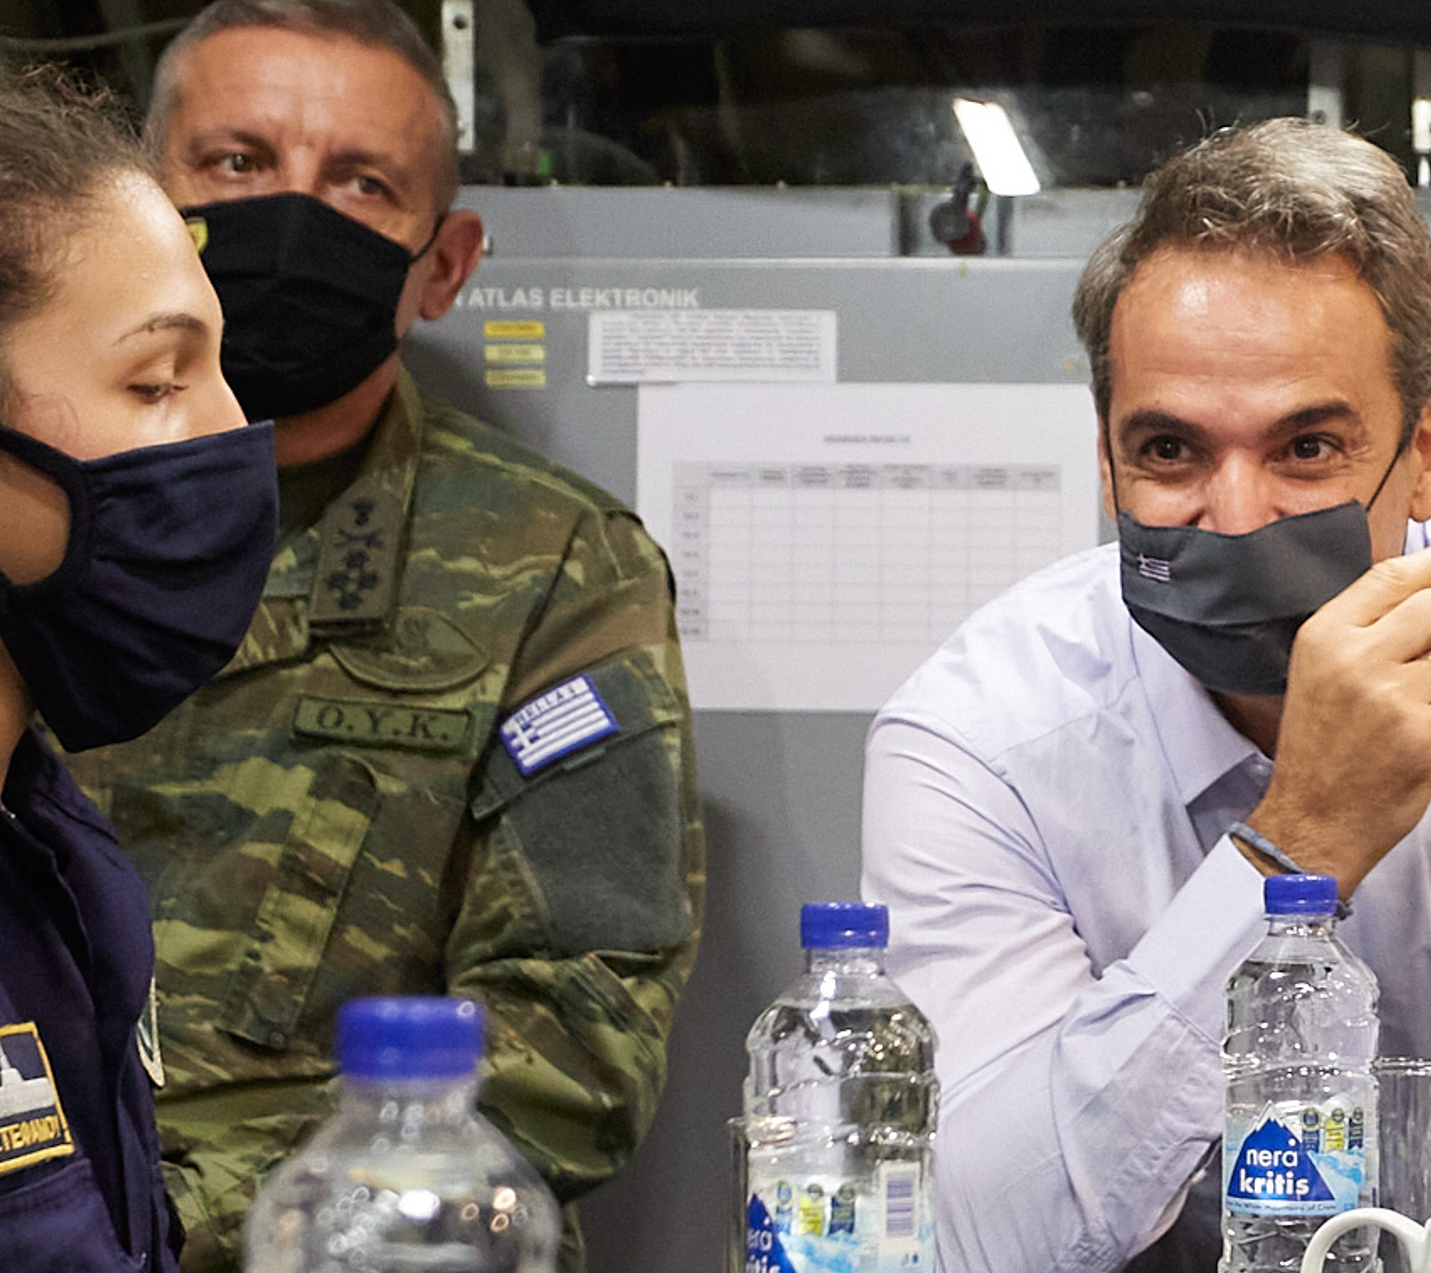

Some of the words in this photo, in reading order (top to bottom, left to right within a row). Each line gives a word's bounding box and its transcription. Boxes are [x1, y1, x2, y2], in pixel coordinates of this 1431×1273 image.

[469, 287, 543, 308] ATLAS
[550, 287, 699, 309] ELEKTRONIK
[1238, 1168, 1310, 1196] kritis
